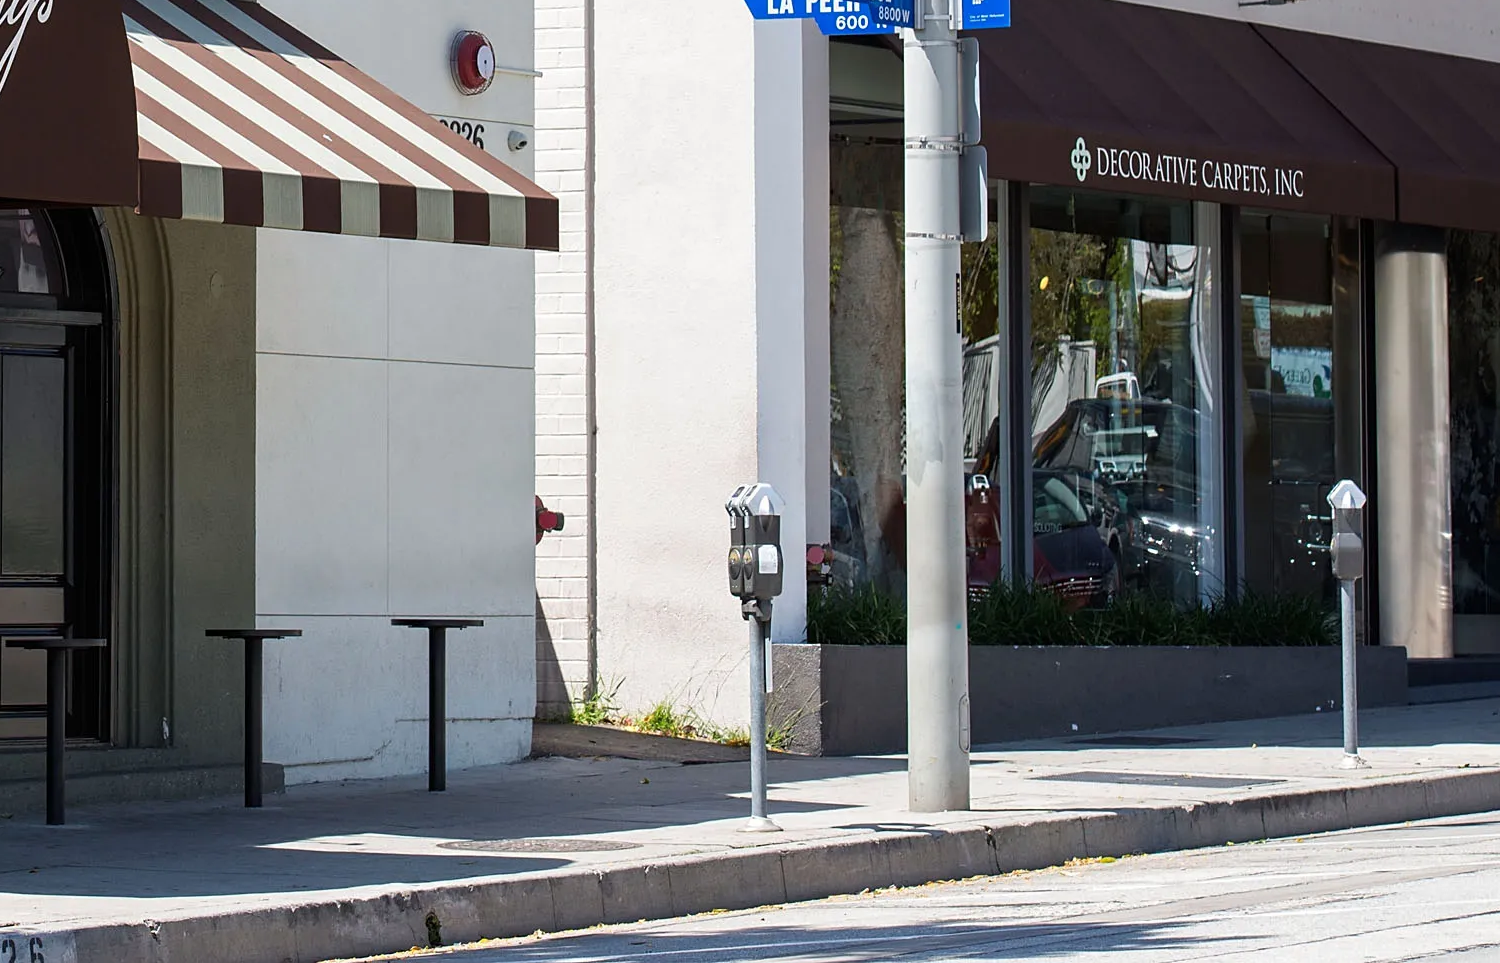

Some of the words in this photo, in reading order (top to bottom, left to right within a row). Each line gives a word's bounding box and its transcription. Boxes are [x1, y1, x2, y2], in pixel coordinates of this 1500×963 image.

[835, 14, 869, 31] 600
[878, 6, 901, 22] 8800
[902, 9, 911, 23] W
[1096, 147, 1197, 186] DECORATIVE
[1202, 160, 1270, 196] CARPETS,
[1275, 168, 1304, 198] INC
